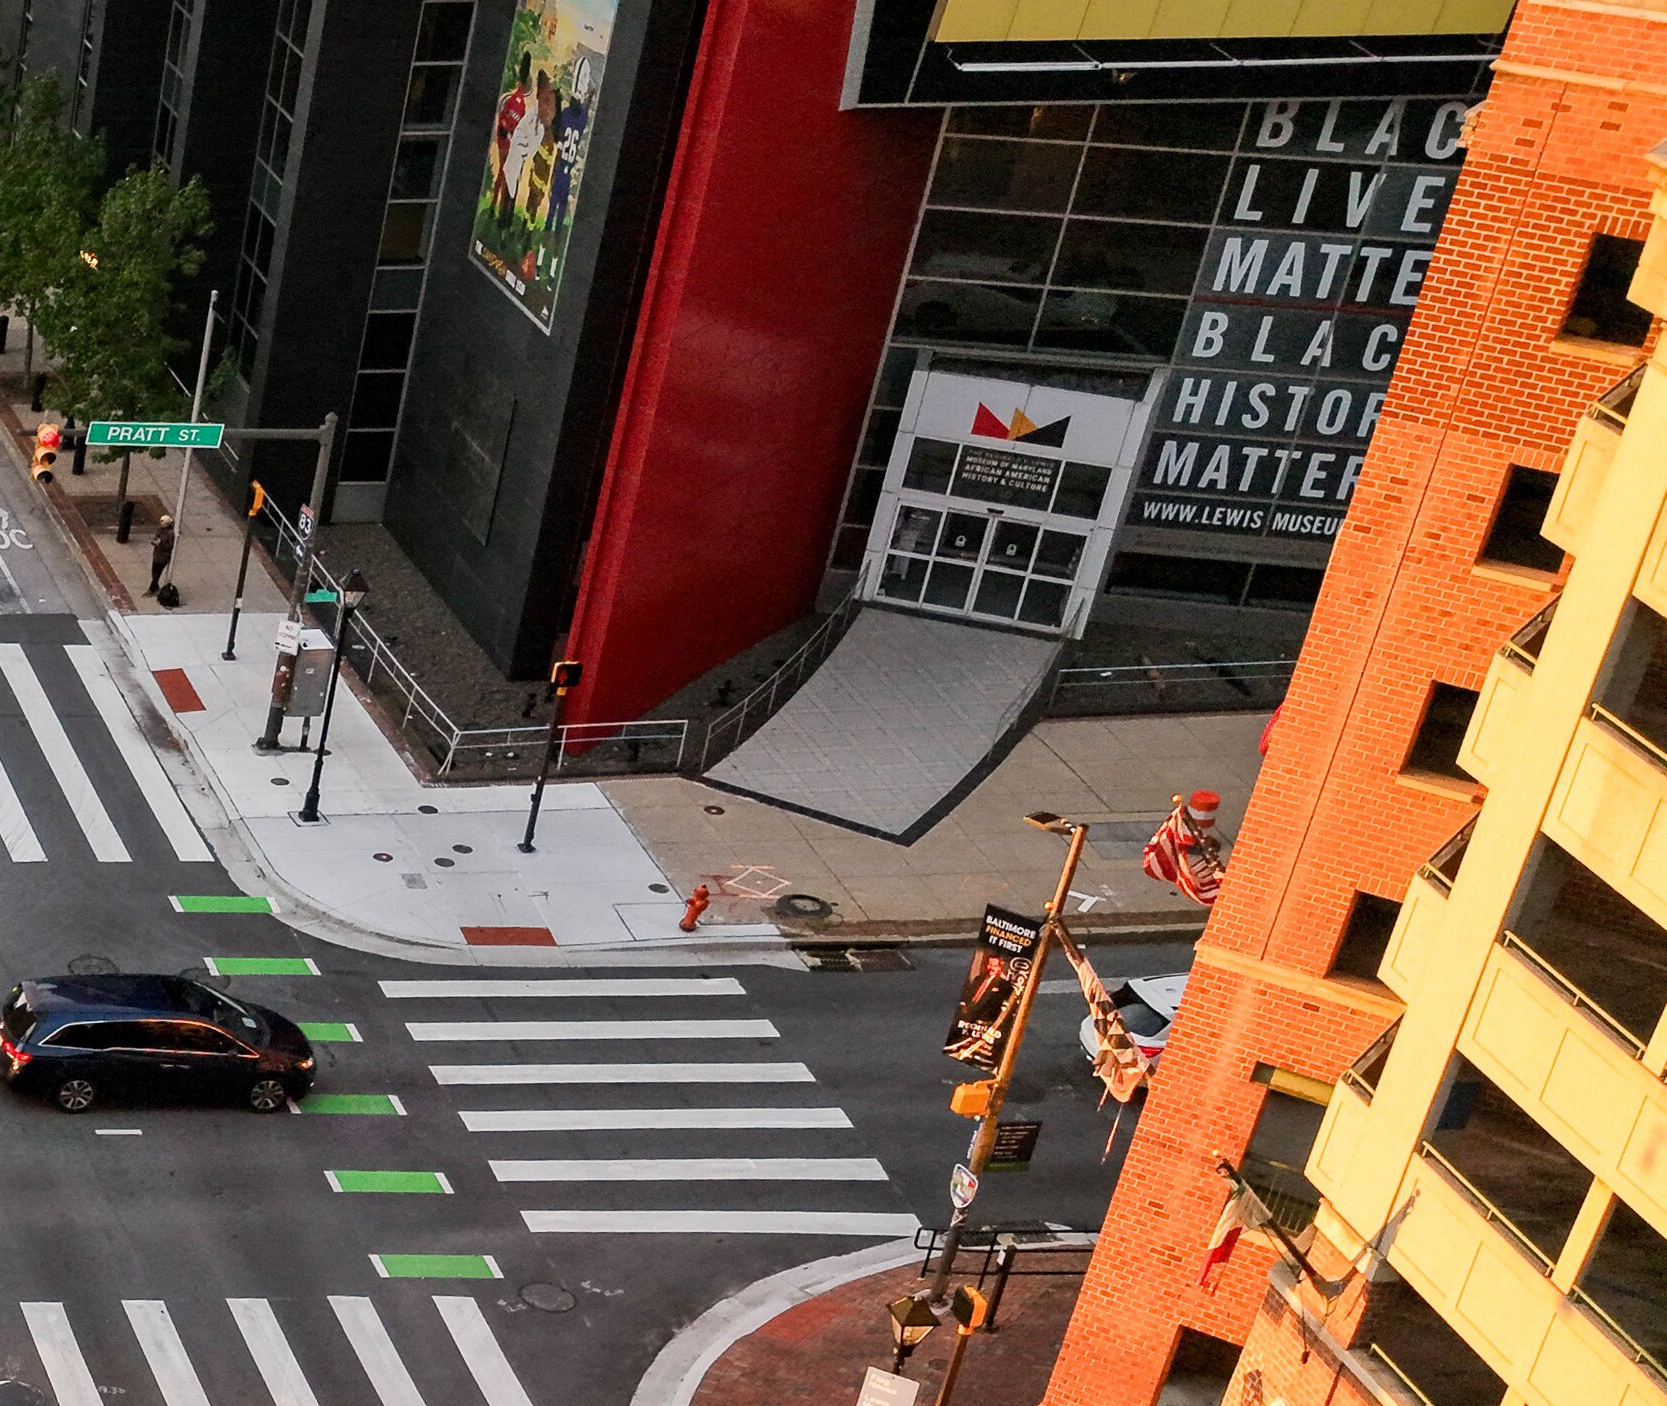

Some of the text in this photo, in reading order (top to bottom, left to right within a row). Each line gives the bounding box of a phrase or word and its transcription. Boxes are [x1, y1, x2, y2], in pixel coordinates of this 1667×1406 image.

[107, 426, 200, 442] PRATT ST.
[961, 472, 998, 483] HISTORY
[1008, 480, 1047, 492] CULTURE
[965, 464, 1051, 483] AFRICAN AMERICAN
[299, 514, 311, 534] 83
[1272, 513, 1345, 536] MUSEU
[986, 915, 1037, 939] BALTIMORE
[986, 925, 1032, 946] FINANCED
[989, 935, 1023, 953] IT FIRST
